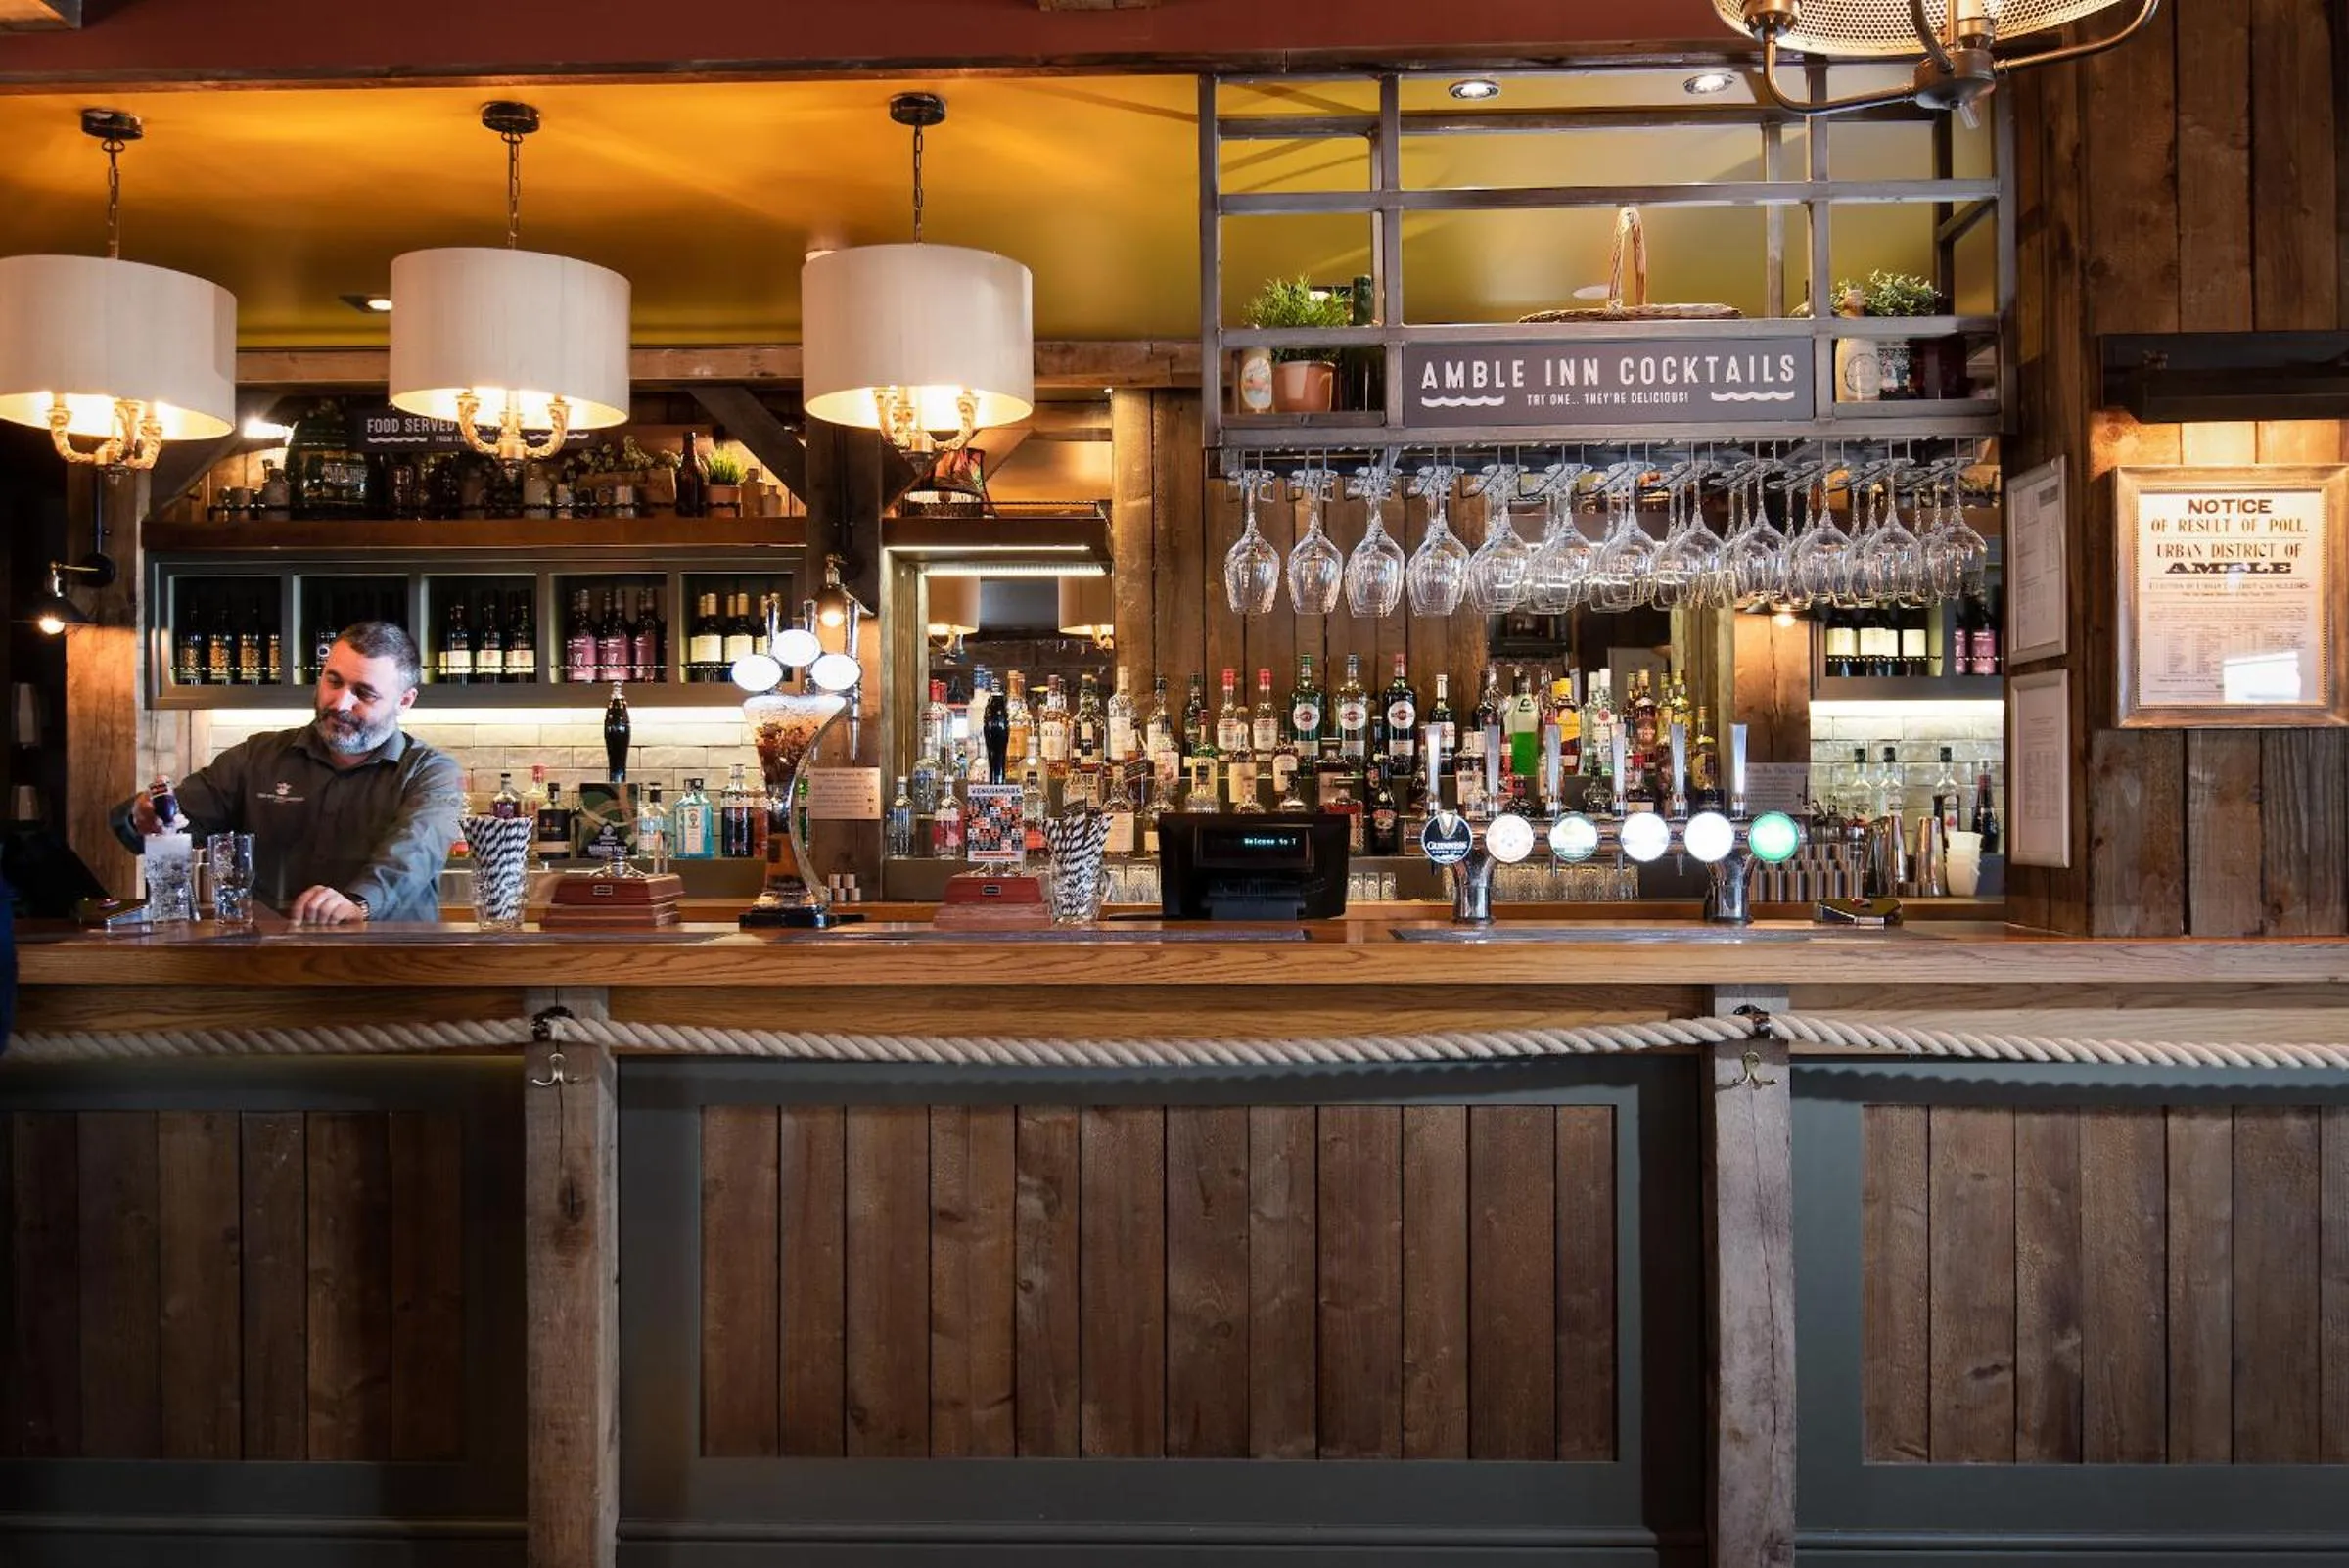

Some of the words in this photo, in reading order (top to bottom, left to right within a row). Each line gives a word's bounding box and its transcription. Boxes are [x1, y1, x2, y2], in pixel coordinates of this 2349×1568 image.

[1421, 360, 1524, 389] AMBLE
[1545, 358, 1599, 386] INN
[1620, 354, 1795, 385] COCKTAILS
[1527, 393, 1545, 406] TRY
[1585, 392, 1627, 404] THEY'RE
[1631, 392, 1689, 403] DELICIOUS!
[367, 418, 400, 433] FOOD
[404, 419, 455, 433] SERVED
[2188, 499, 2272, 514] NOTICE
[2151, 519, 2168, 532] OF
[2178, 519, 2231, 532] RESULT
[2241, 519, 2258, 532] OF
[2269, 519, 2308, 533] POLL.
[2156, 544, 2202, 558] URBAN
[2211, 544, 2276, 558] DISTRICT
[2284, 544, 2302, 558] OF
[2165, 562, 2291, 575] AMBLE
